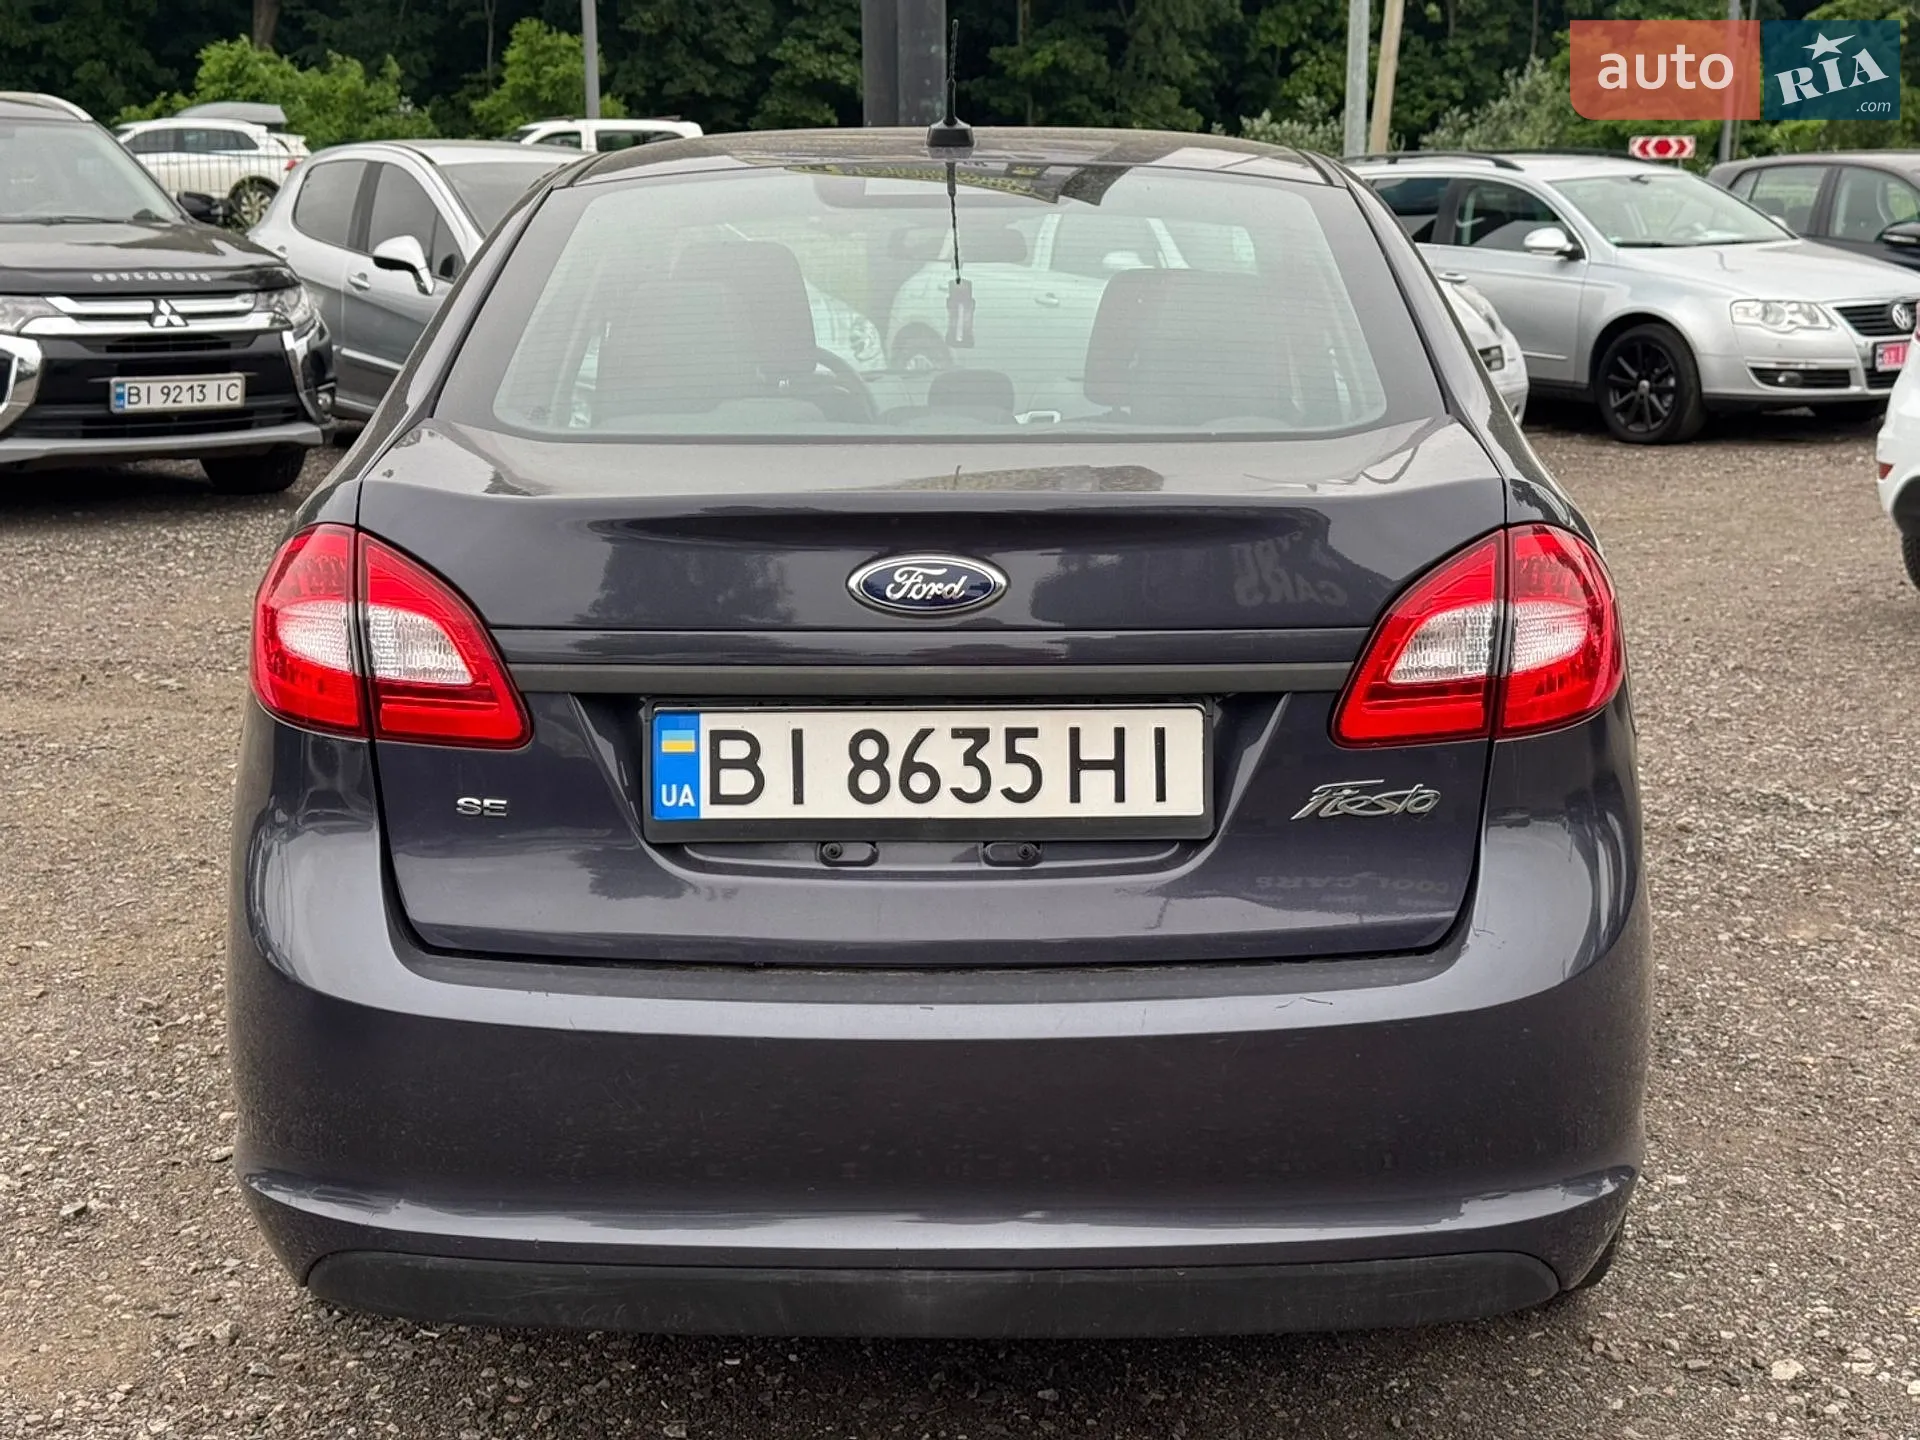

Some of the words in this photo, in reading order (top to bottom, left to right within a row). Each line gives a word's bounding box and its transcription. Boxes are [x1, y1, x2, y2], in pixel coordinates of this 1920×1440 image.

[127, 385, 151, 405] BI
[160, 384, 207, 404] 9213
[217, 383, 240, 402] IC
[885, 566, 968, 600] Ford
[709, 728, 804, 805] BI
[847, 727, 1043, 804] 8635
[1069, 726, 1166, 803] HI
[456, 797, 507, 817] SE
[661, 784, 696, 807] UA
[1290, 778, 1441, 821] Fiesta
